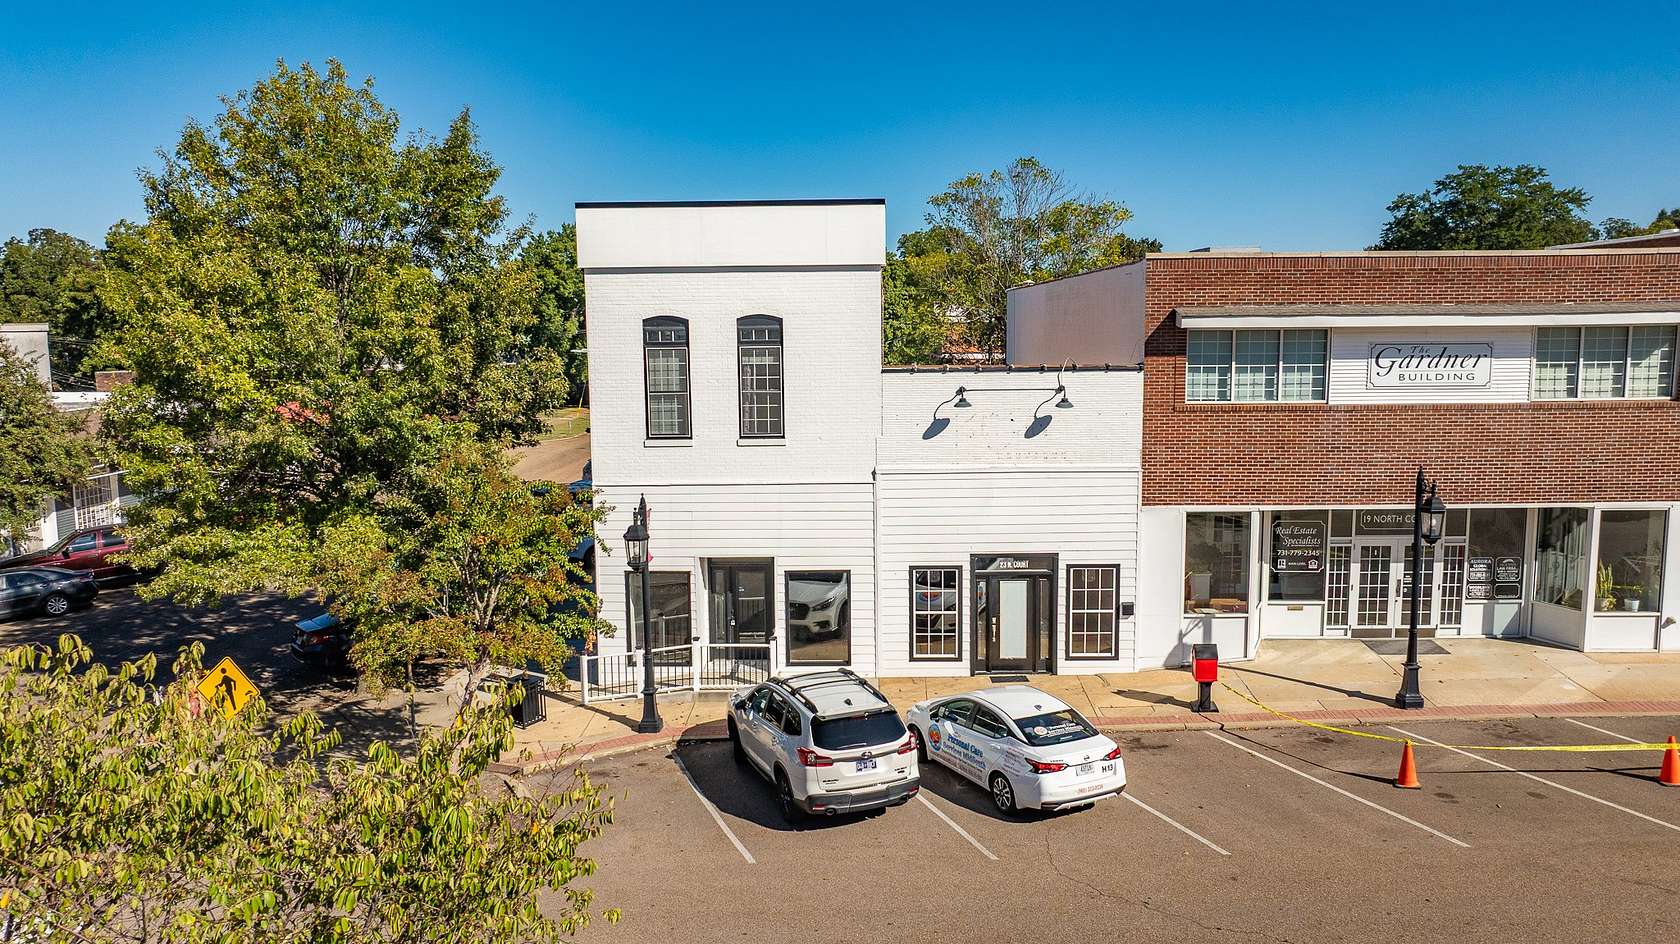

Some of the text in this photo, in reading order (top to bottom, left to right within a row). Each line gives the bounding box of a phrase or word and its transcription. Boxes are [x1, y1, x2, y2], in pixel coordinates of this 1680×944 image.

[1411, 346, 1430, 354] The
[1375, 346, 1487, 377] Gardner
[1398, 373, 1475, 381] BUILDING
[1363, 515, 1371, 523] 19
[1373, 515, 1403, 523] NORTH
[1275, 526, 1317, 535] Real Estate
[1282, 535, 1321, 547] Specialists
